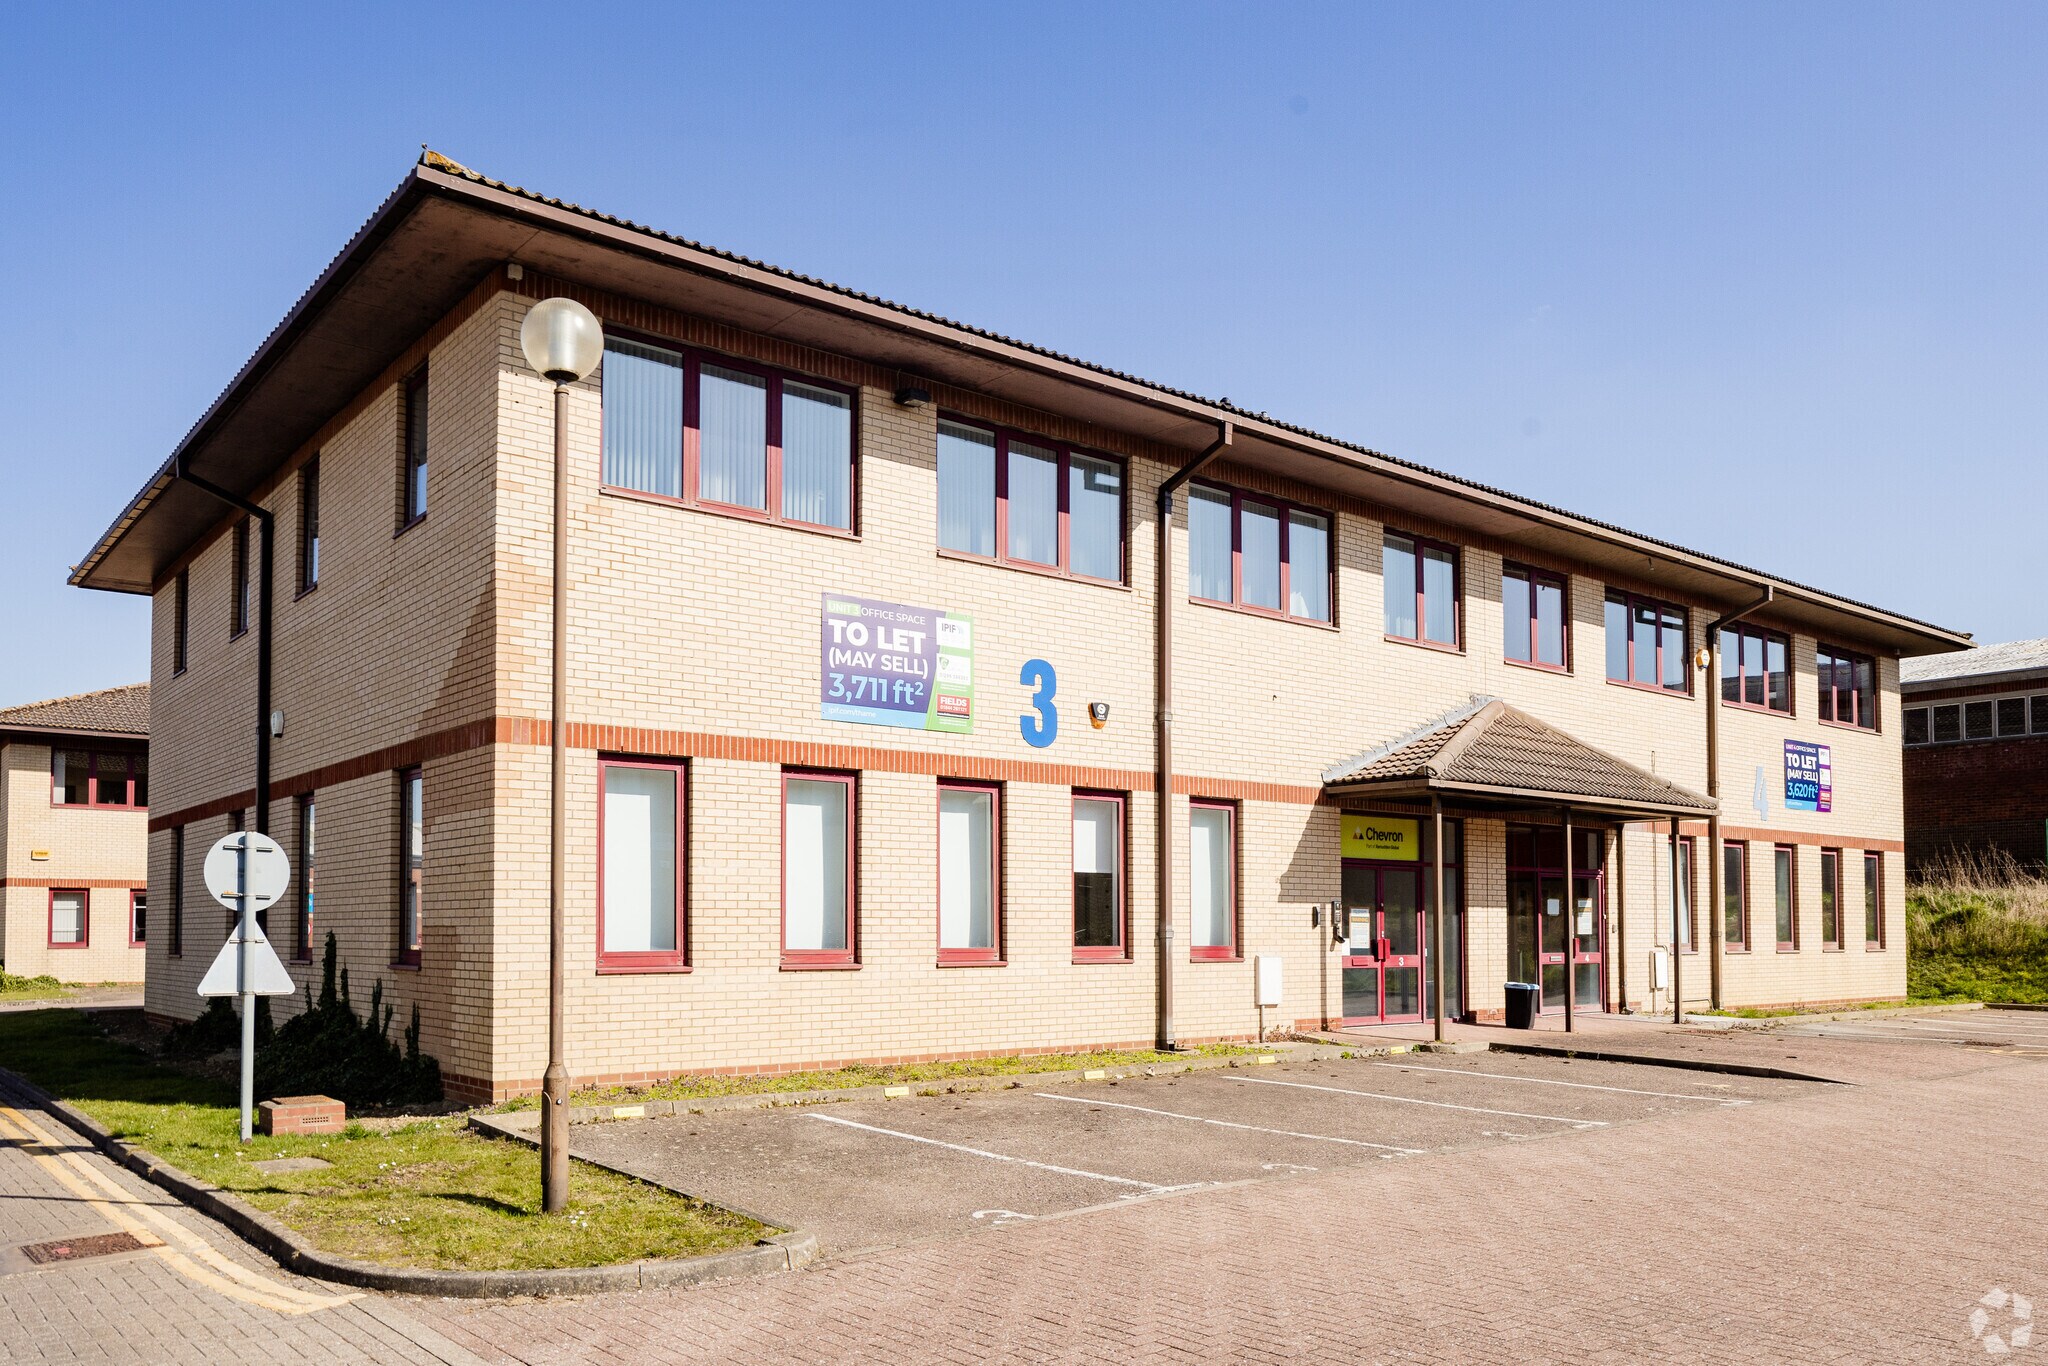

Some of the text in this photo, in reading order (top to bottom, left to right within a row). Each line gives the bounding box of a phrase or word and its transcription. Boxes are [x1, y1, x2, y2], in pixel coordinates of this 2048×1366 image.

[828, 601, 926, 626] UNIT 3 OFFICE SPACE
[828, 618, 926, 655] TO LET
[941, 622, 956, 633] IPIF
[828, 646, 928, 679] (MAY SELL)
[828, 672, 887, 702] 3,711
[940, 696, 968, 708] FIELDS
[1020, 659, 1058, 748] 3
[1786, 752, 1817, 770] TO LET
[1787, 768, 1818, 784] (MAY SELL)
[1753, 766, 1768, 821] 4
[1787, 782, 1808, 798] 3,620
[1366, 826, 1403, 842] Chevron
[1399, 957, 1404, 967] 3
